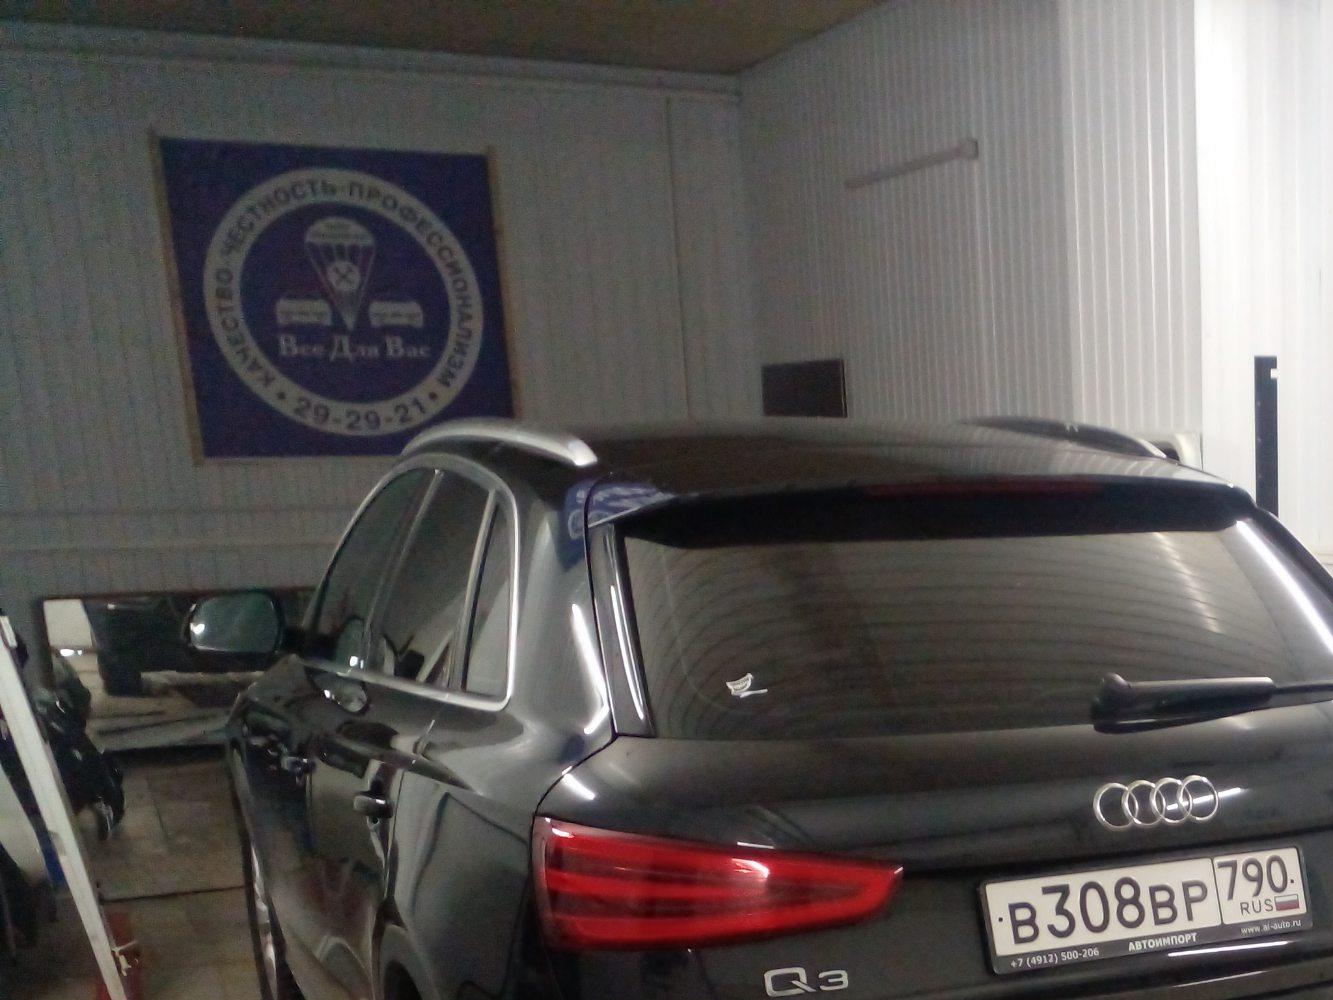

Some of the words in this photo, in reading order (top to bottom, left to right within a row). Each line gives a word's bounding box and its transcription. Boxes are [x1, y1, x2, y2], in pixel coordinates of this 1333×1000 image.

[293, 396, 428, 432] 29-29-21
[1008, 876, 1208, 945] В308ВР
[1218, 854, 1289, 901] 790
[1240, 898, 1274, 915] RUS
[1128, 932, 1198, 952] АВТОИМПОРТ
[1010, 956, 1024, 968] +7
[1026, 952, 1059, 968] (4912)
[1061, 947, 1100, 962] 500-206
[764, 966, 849, 998] Q3
